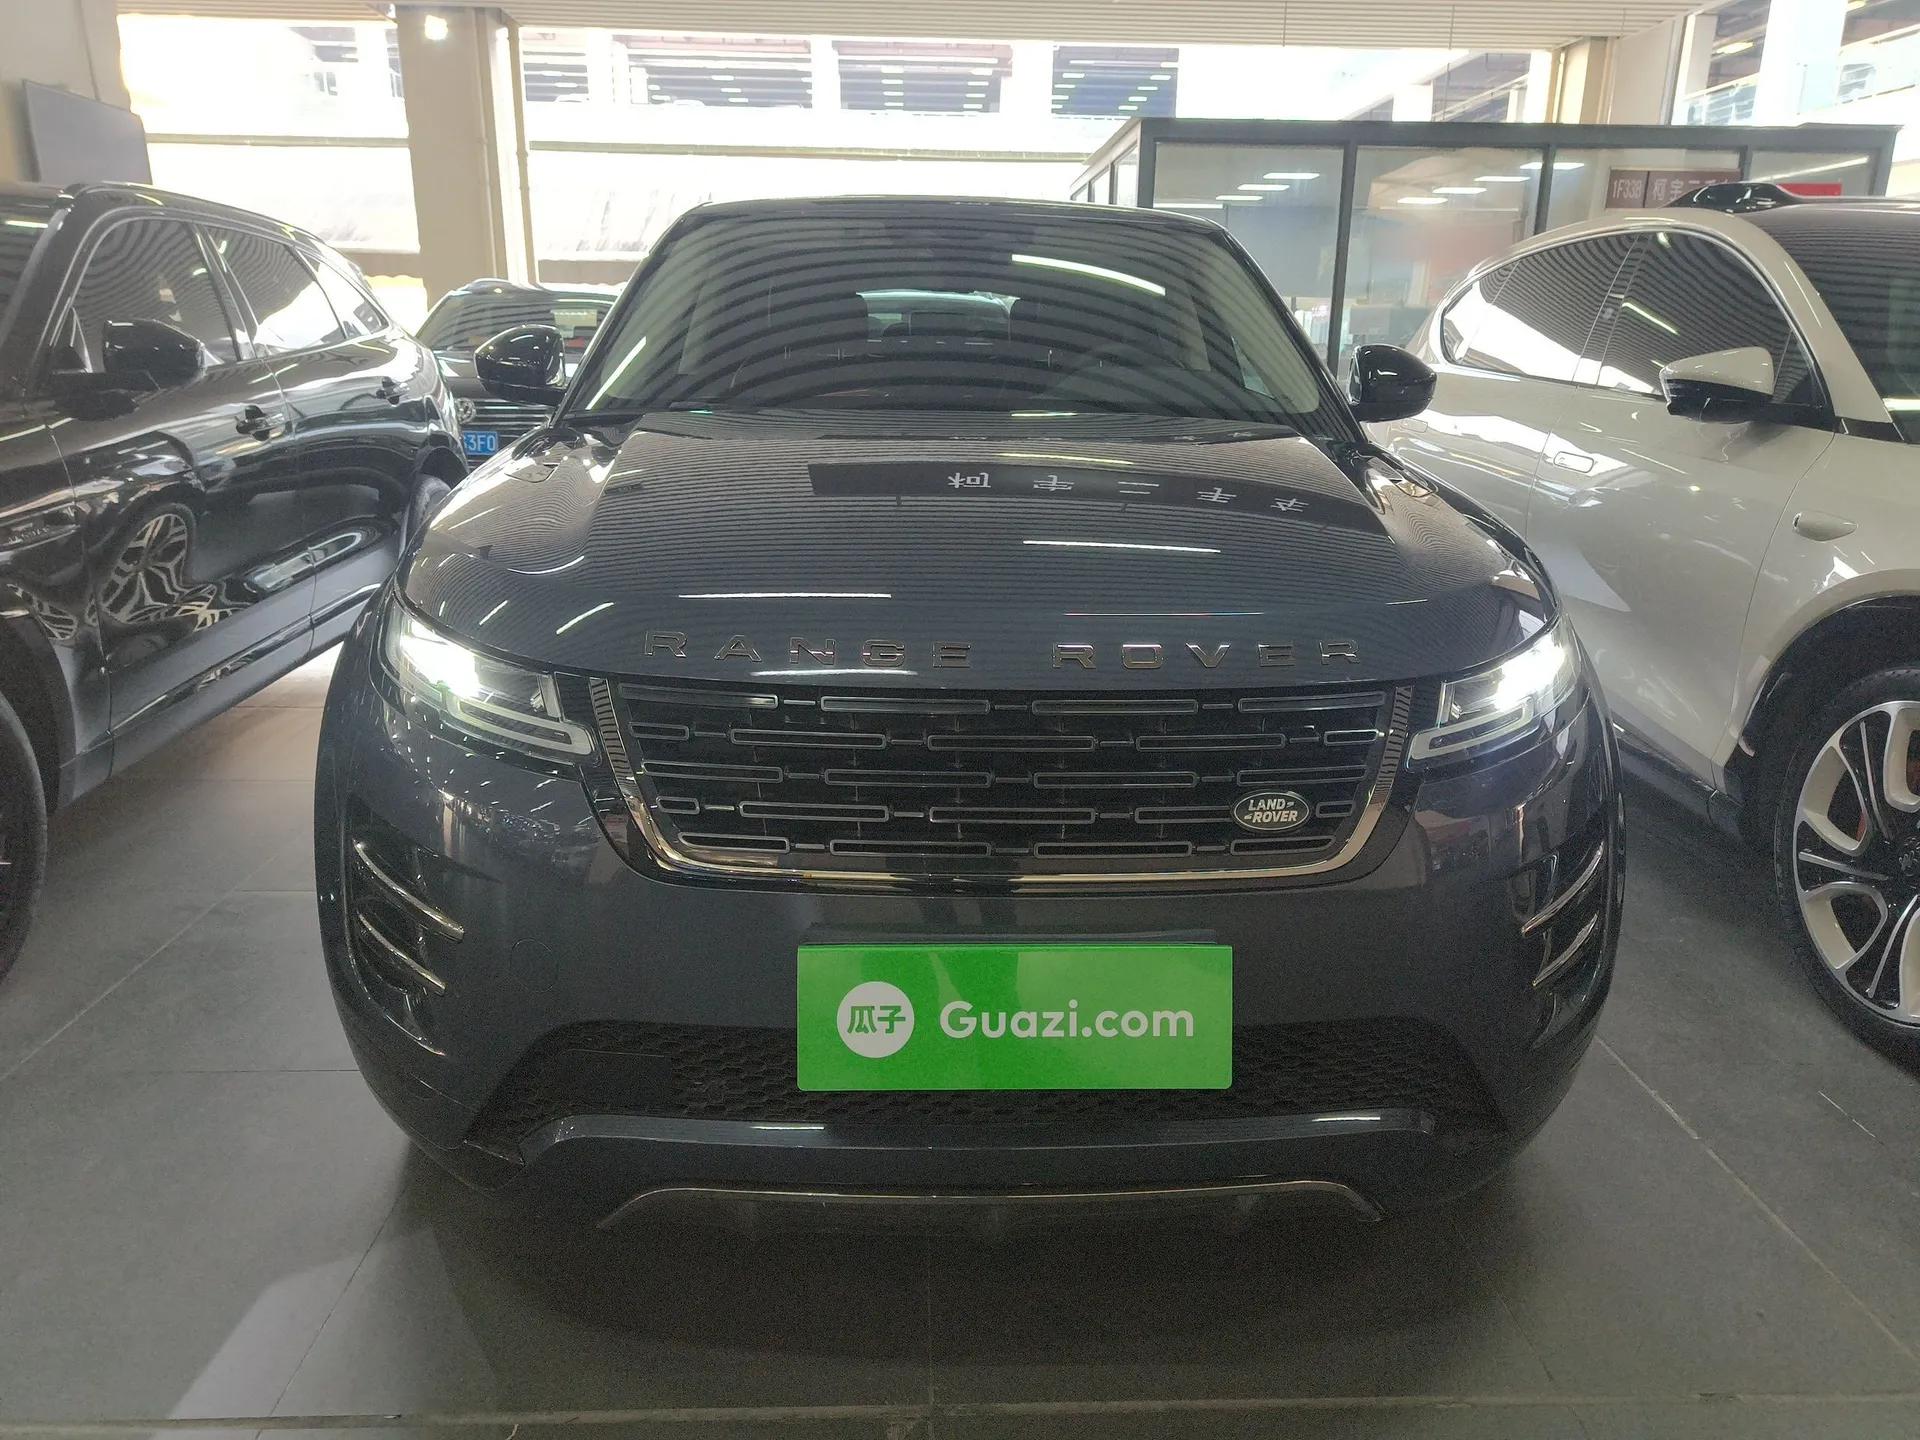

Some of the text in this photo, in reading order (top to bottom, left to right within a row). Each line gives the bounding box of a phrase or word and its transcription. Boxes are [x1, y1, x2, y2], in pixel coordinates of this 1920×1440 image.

[464, 434, 496, 452] 3F0
[644, 630, 1361, 670] RANGE ROVER
[1248, 798, 1286, 811] LAND
[1252, 810, 1298, 823] ROVER
[847, 1005, 906, 1034] 瓜子
[939, 999, 1195, 1039] Guazi.com
